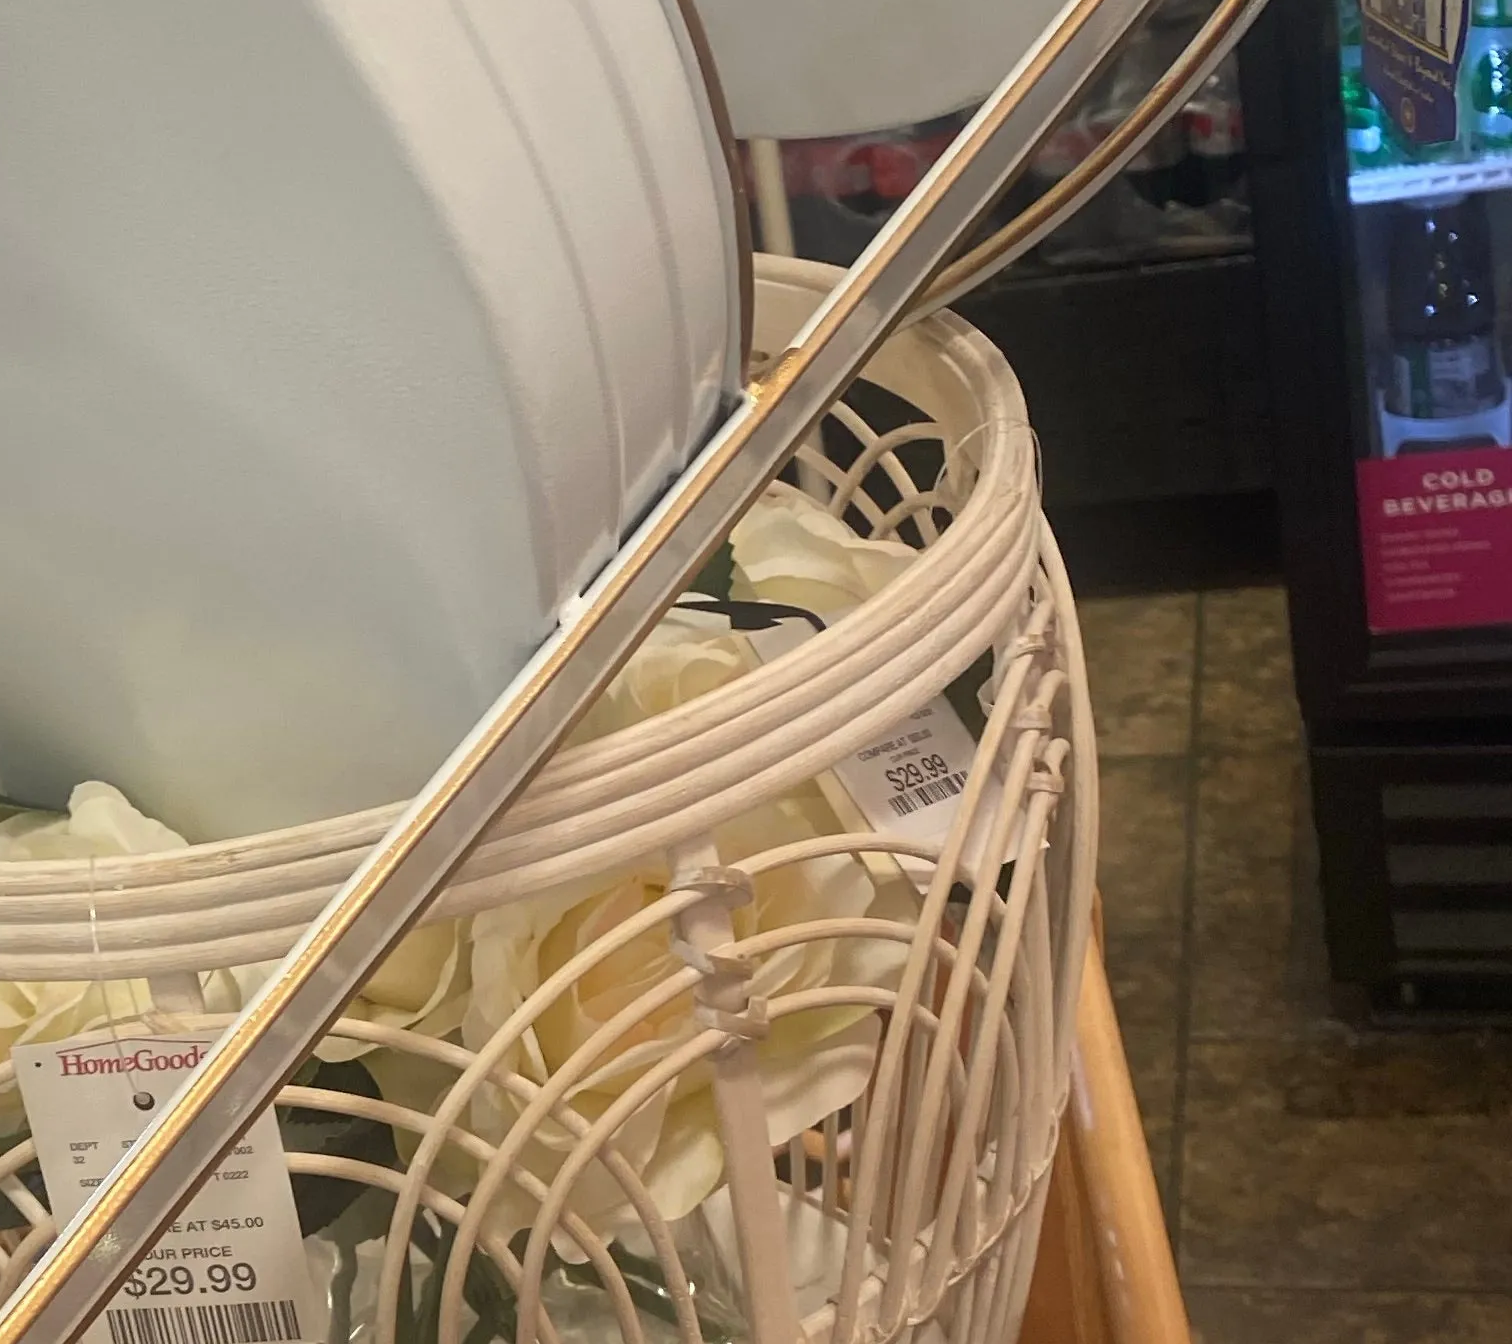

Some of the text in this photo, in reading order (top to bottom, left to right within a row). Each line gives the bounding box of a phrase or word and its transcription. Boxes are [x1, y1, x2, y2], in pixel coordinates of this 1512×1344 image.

[1422, 467, 1495, 491] COLD
[885, 754, 948, 792] $29.99
[187, 1219, 209, 1233] AT
[211, 1216, 264, 1231] $45.00
[181, 1245, 233, 1260] PRICE
[124, 1261, 257, 1300] $29.99
